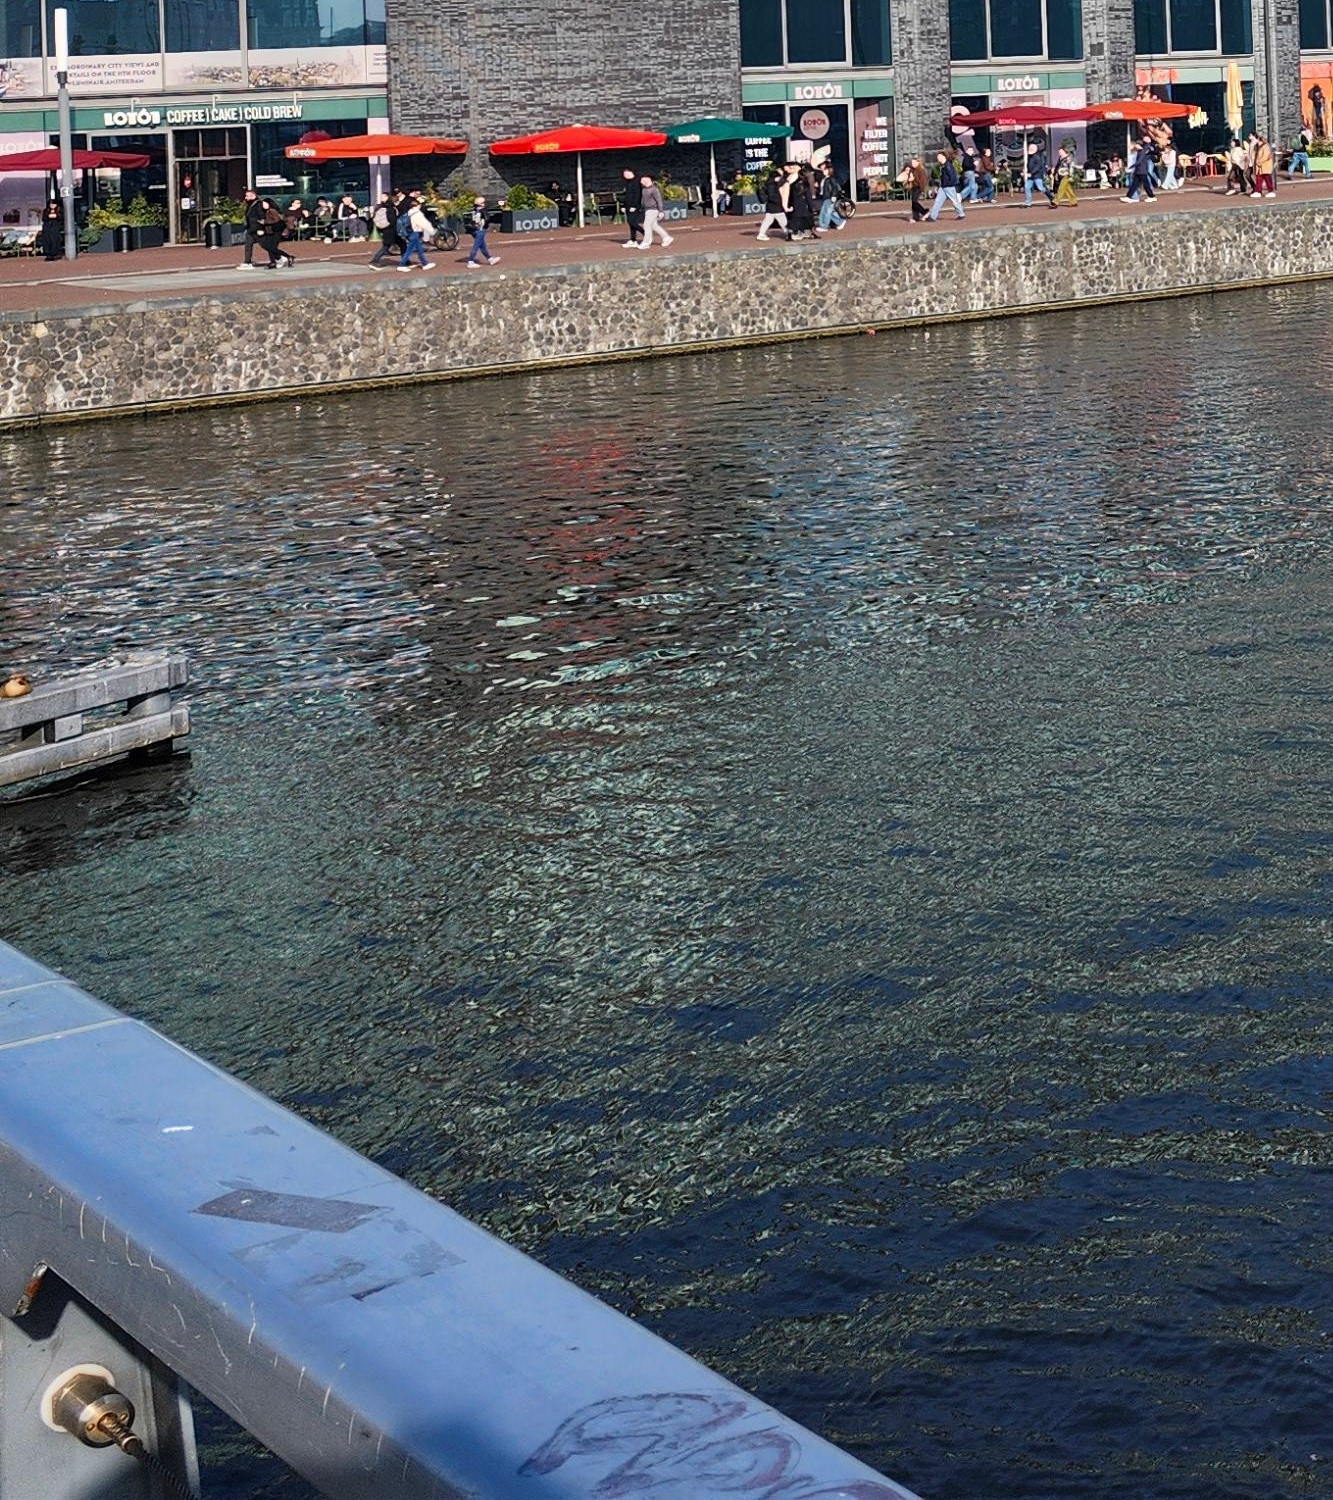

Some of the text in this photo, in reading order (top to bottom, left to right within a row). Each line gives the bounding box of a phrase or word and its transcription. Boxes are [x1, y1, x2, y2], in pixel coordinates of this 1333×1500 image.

[167, 109, 205, 124] COFFEE
[211, 107, 239, 122] CAKE
[245, 106, 272, 120] COLD
[273, 105, 302, 119] BREW
